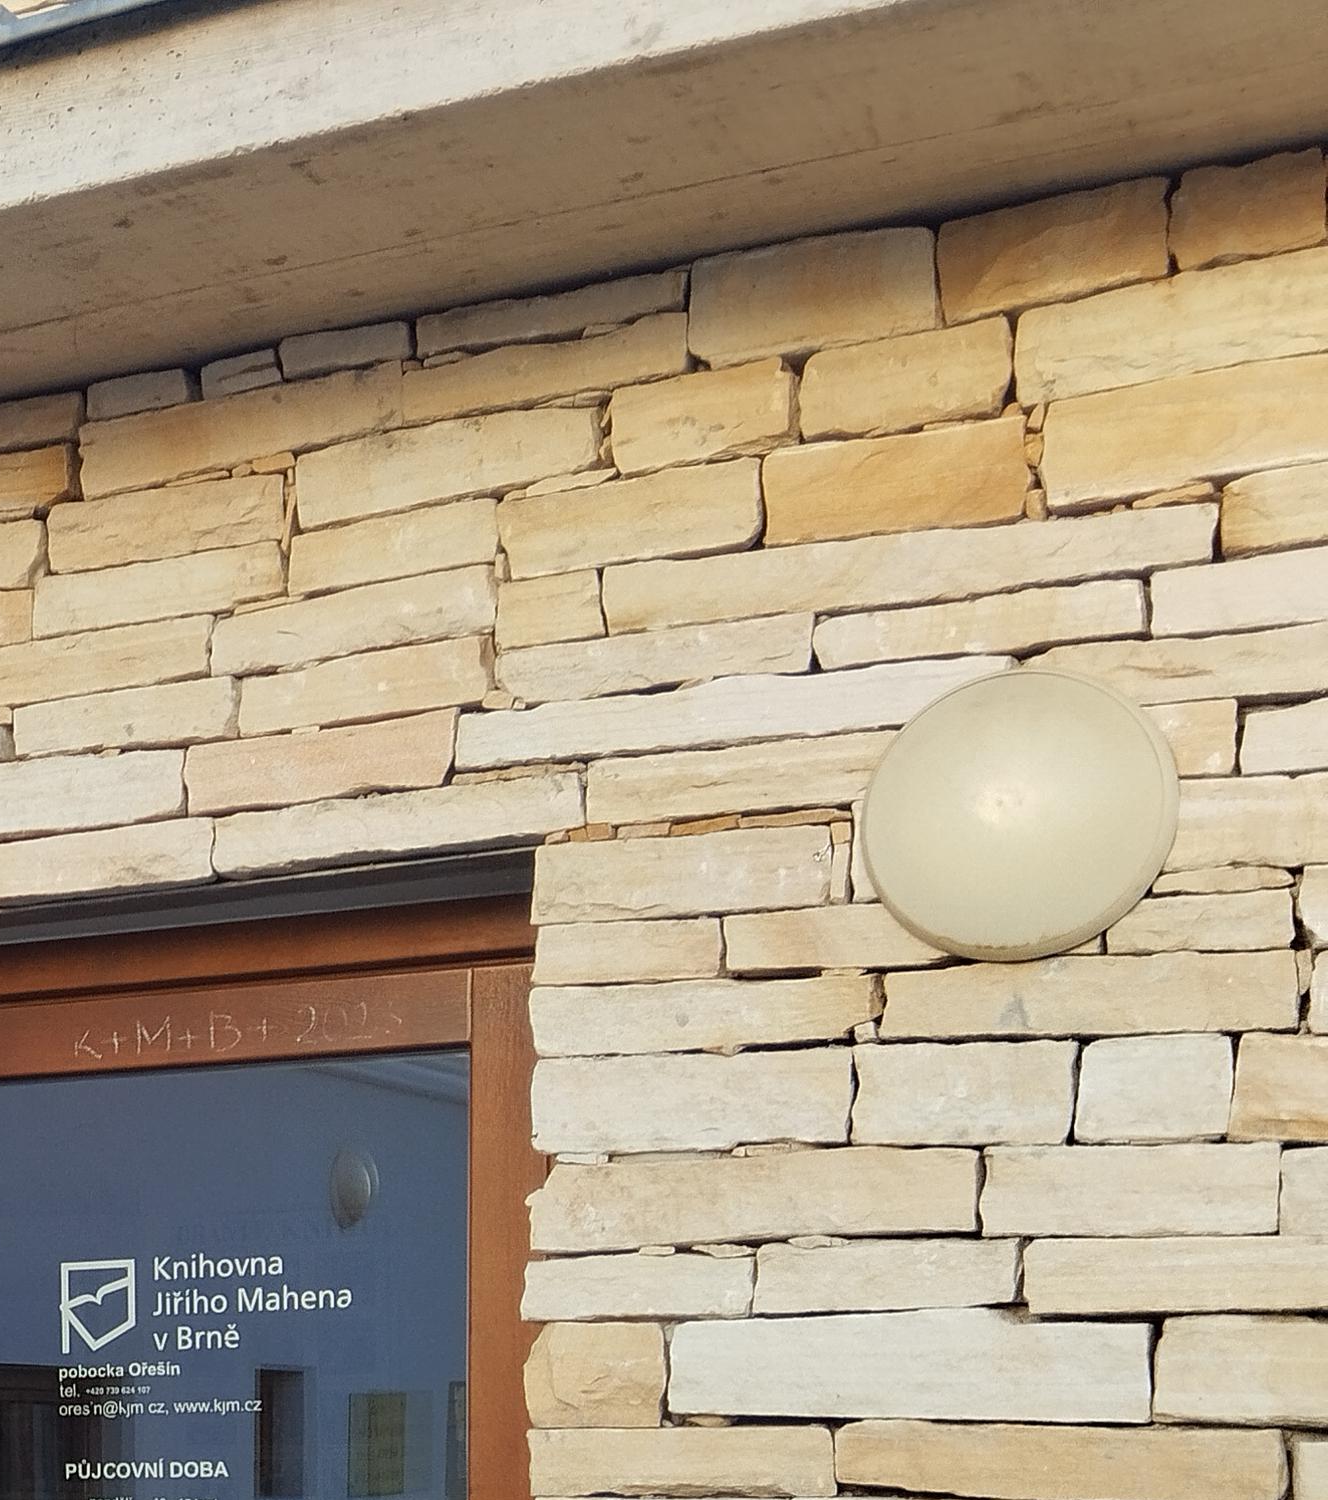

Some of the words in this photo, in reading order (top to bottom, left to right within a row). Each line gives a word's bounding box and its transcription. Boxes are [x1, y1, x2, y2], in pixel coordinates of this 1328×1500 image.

[153, 1253, 284, 1280] Knihovna
[152, 1288, 228, 1316] Jiřího
[237, 1284, 353, 1312] Mahena
[153, 1332, 169, 1351] v
[177, 1323, 240, 1351] Brně
[128, 1361, 181, 1378] Ořešín
[59, 1383, 81, 1399] tel.
[173, 1398, 263, 1415] www.kjm.cz
[169, 1461, 229, 1478] DOBA
